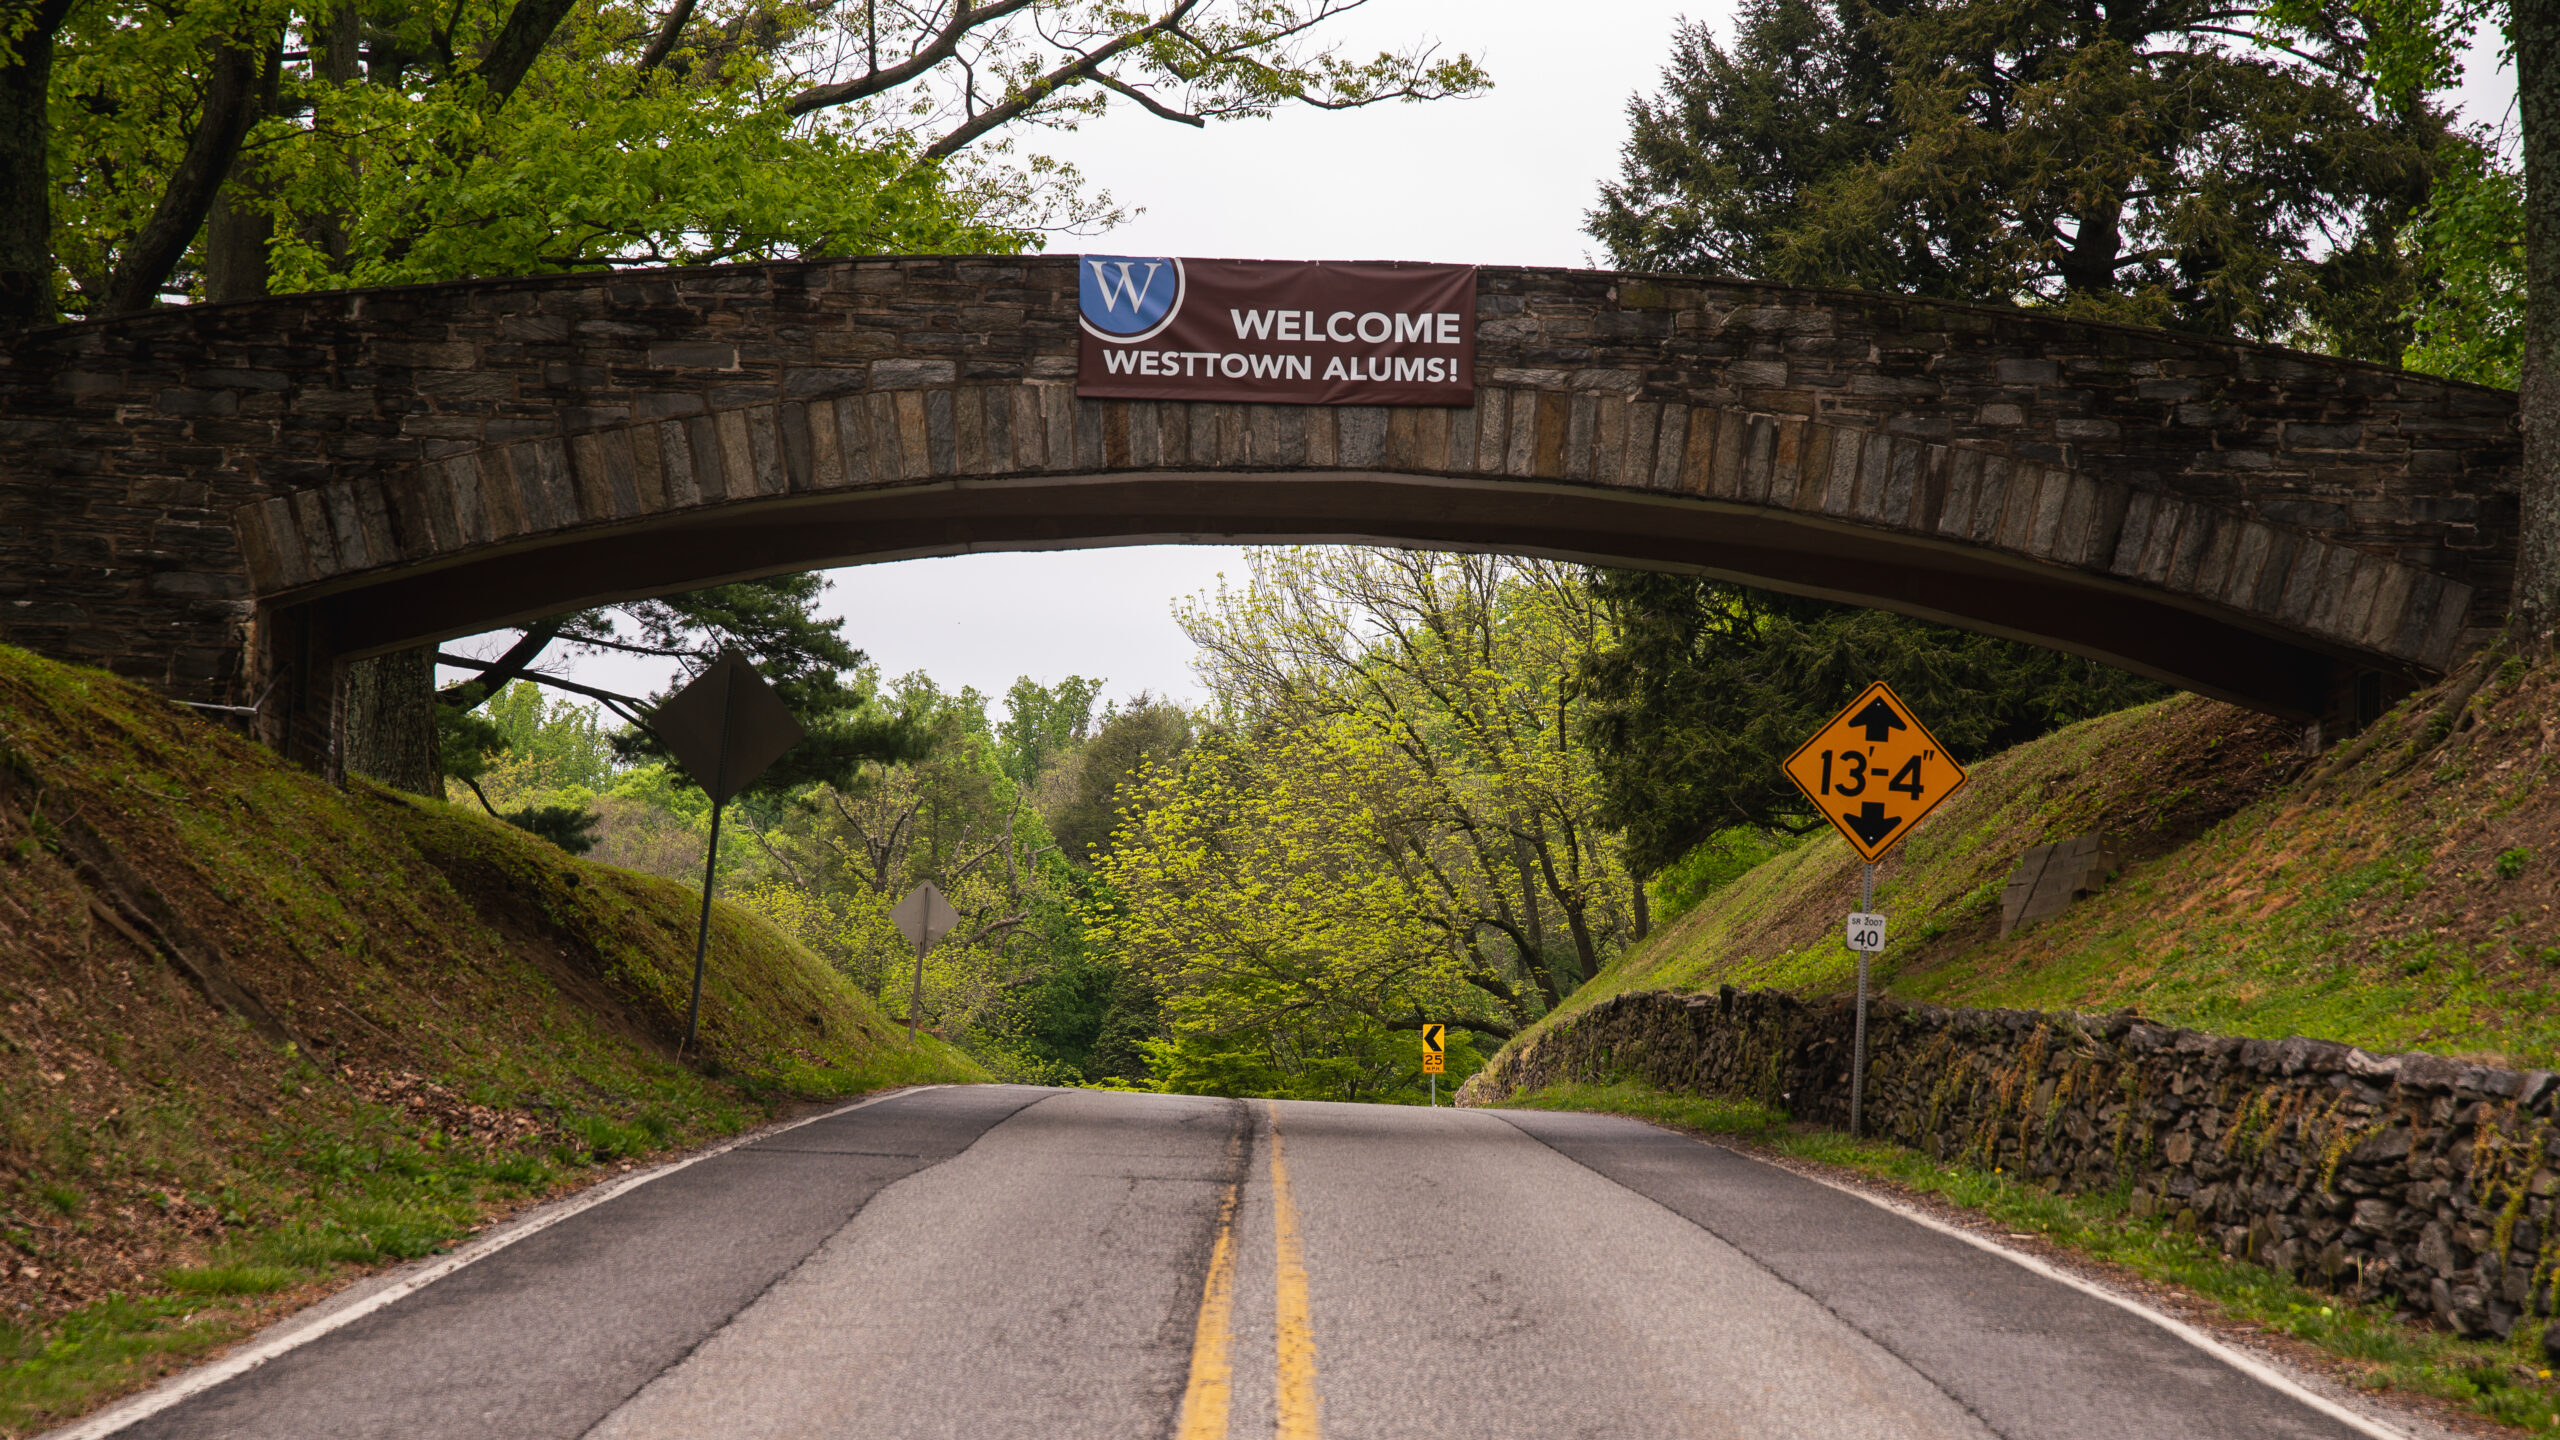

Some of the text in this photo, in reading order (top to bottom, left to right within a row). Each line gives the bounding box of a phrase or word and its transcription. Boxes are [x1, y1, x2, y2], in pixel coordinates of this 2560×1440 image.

[1088, 260, 1163, 314] W
[1230, 308, 1461, 344] WELCOME
[1102, 349, 1459, 383] WESTTOWN ALUMS!
[1851, 917, 1861, 925] SR
[1854, 930, 1878, 947] 40
[1425, 1054, 1443, 1065] 25
